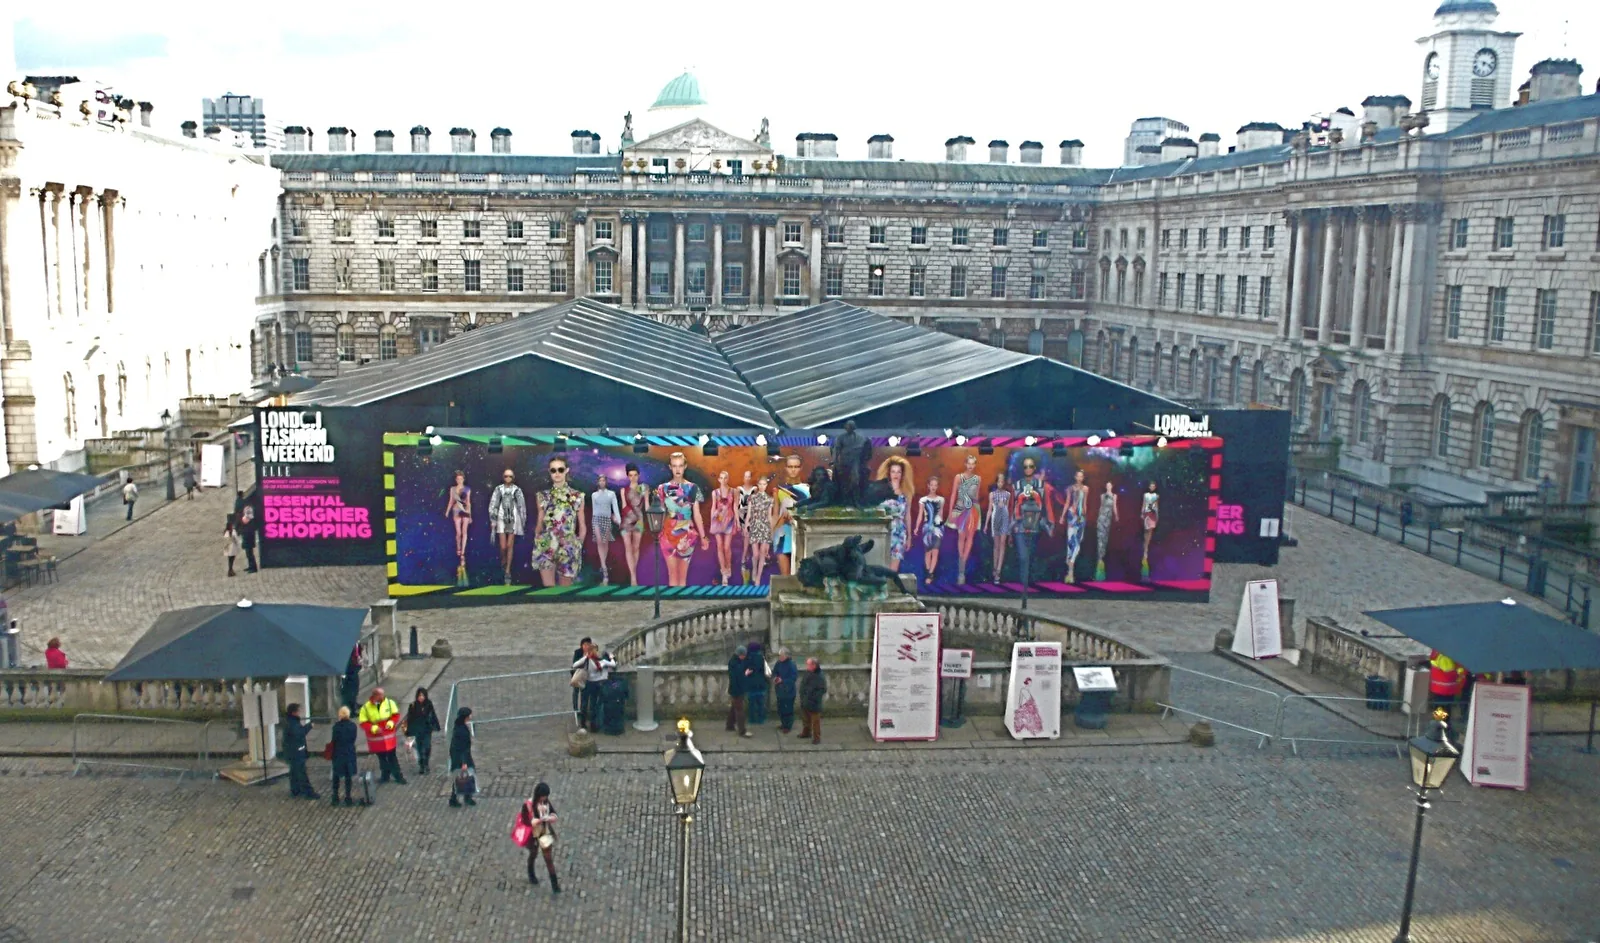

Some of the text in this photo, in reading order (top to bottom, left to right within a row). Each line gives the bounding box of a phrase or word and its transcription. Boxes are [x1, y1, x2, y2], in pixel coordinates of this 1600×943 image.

[261, 428, 327, 445] FASHION
[262, 445, 335, 463] WEEKEND
[262, 466, 290, 476] ELLE
[264, 496, 344, 506] ESSENTIAL
[264, 507, 369, 523] DESIGNER
[265, 523, 373, 538] SHOPPING
